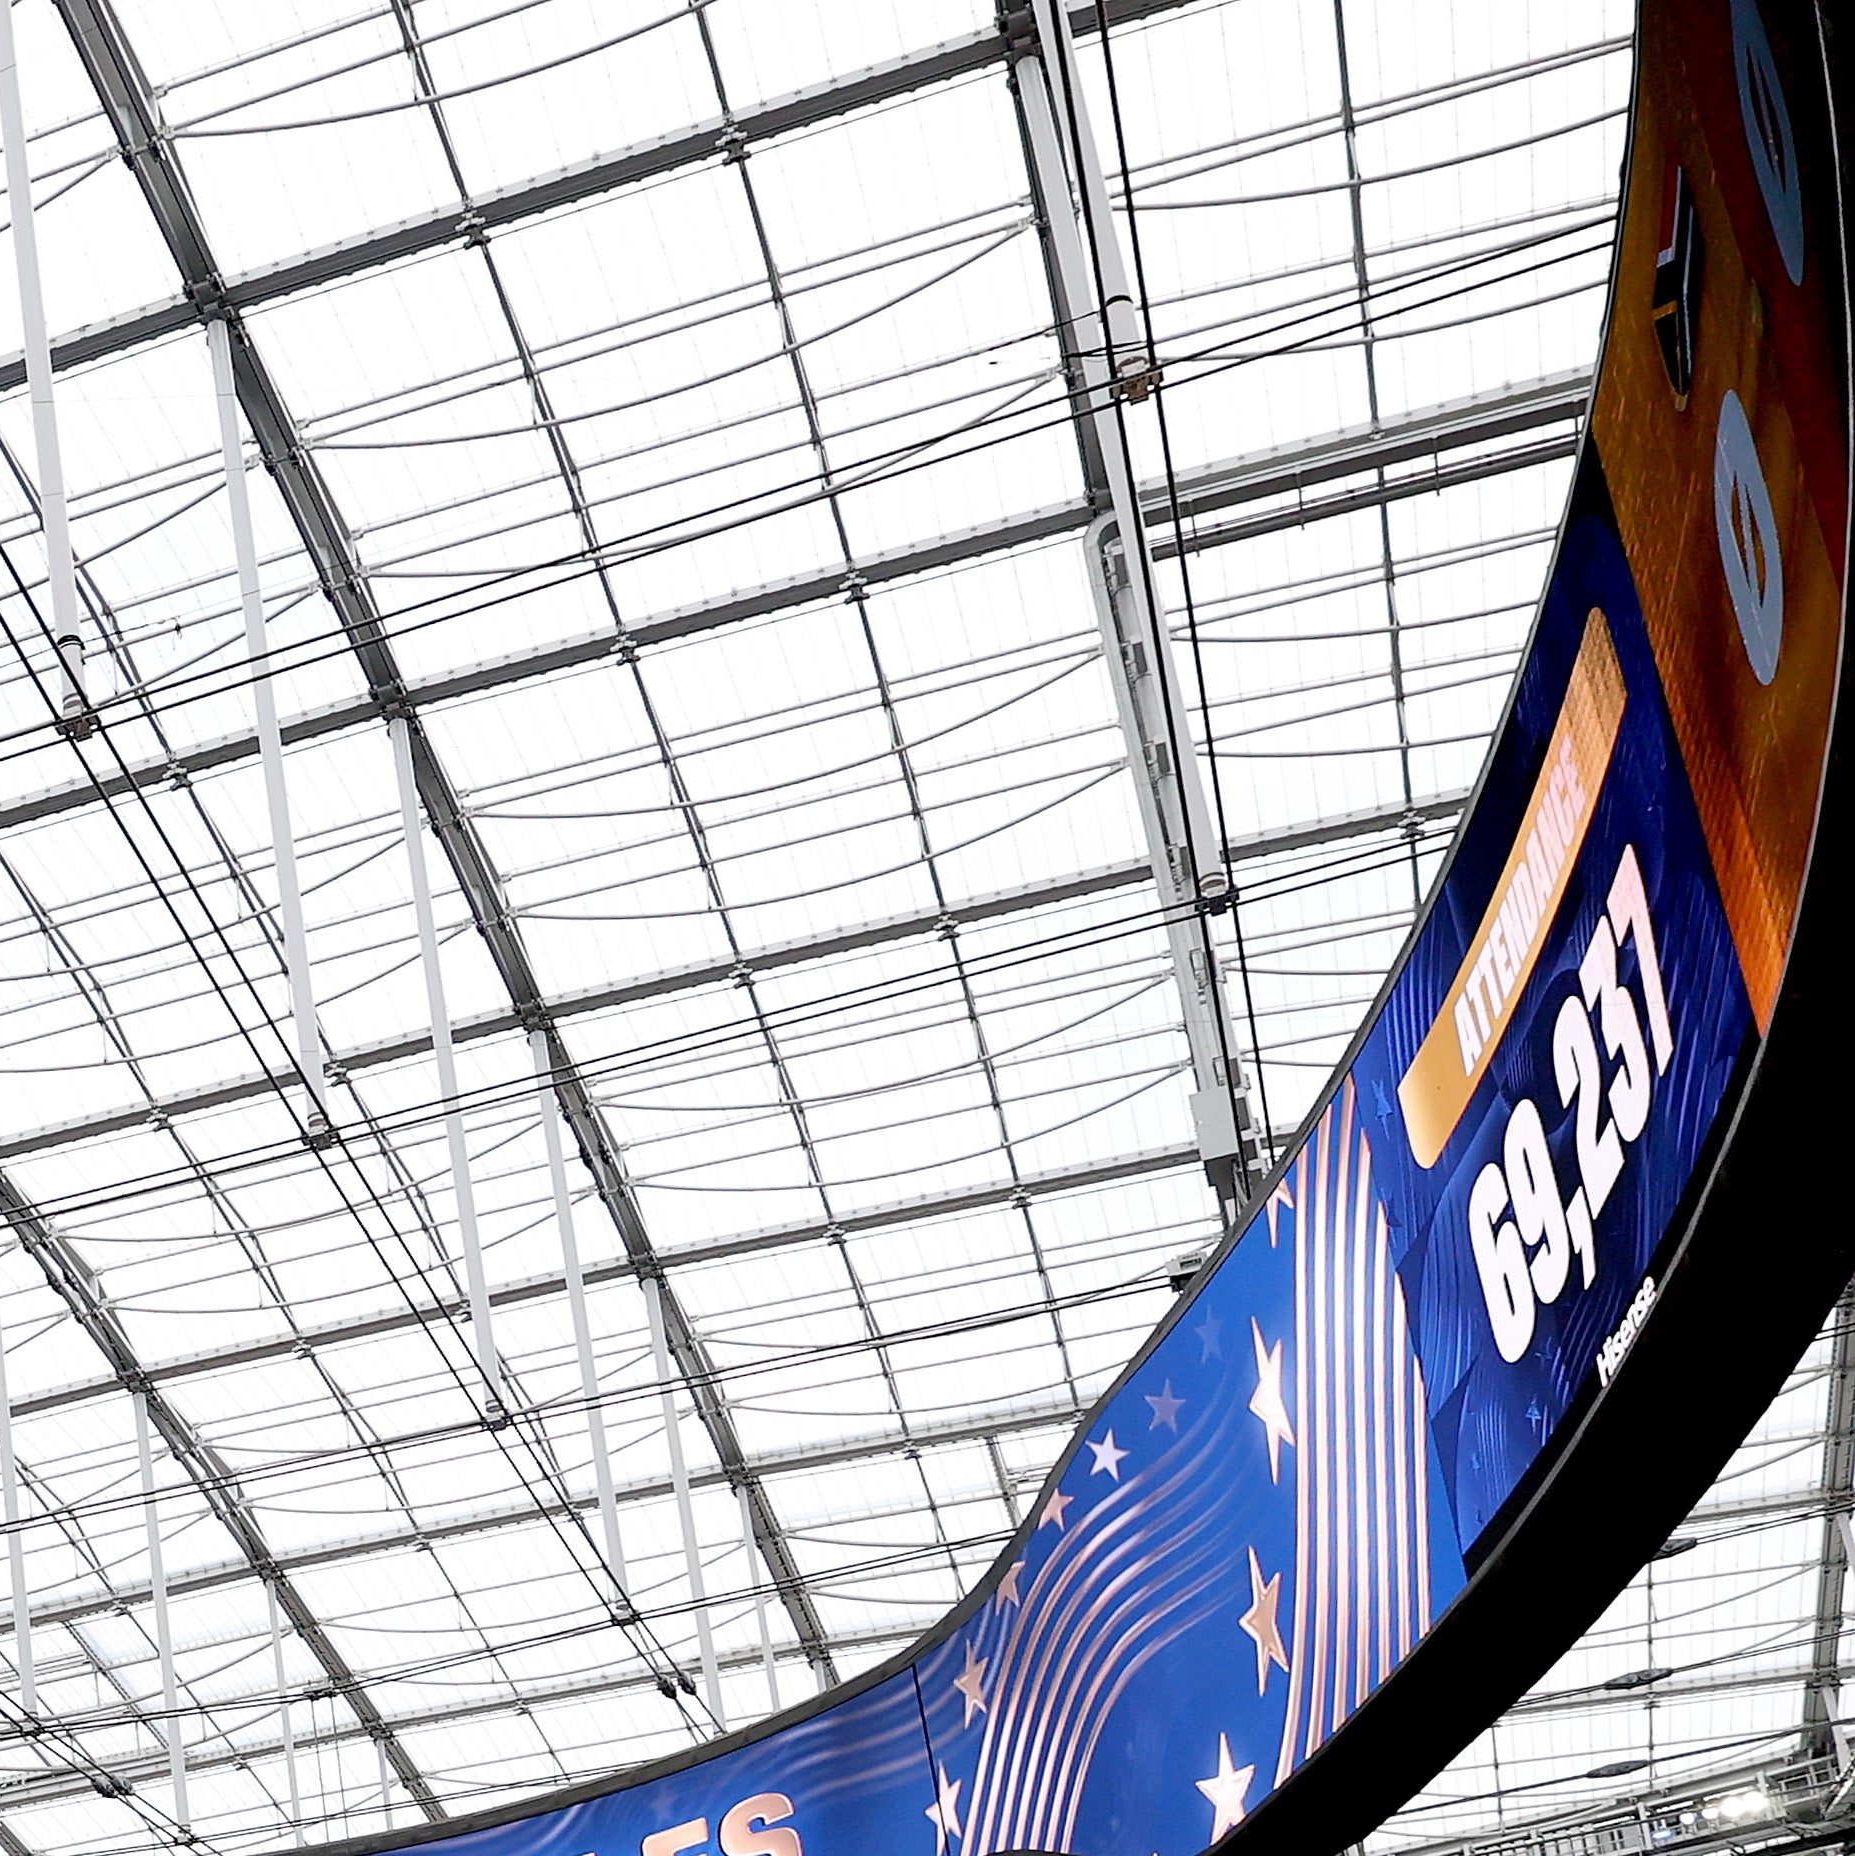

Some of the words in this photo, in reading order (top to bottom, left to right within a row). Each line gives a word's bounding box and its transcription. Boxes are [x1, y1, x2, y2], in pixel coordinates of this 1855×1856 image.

[1452, 736, 1588, 1077] ATTENDANCE
[1467, 843, 1676, 1363] 69,237
[1594, 1275, 1658, 1388] Hisense
